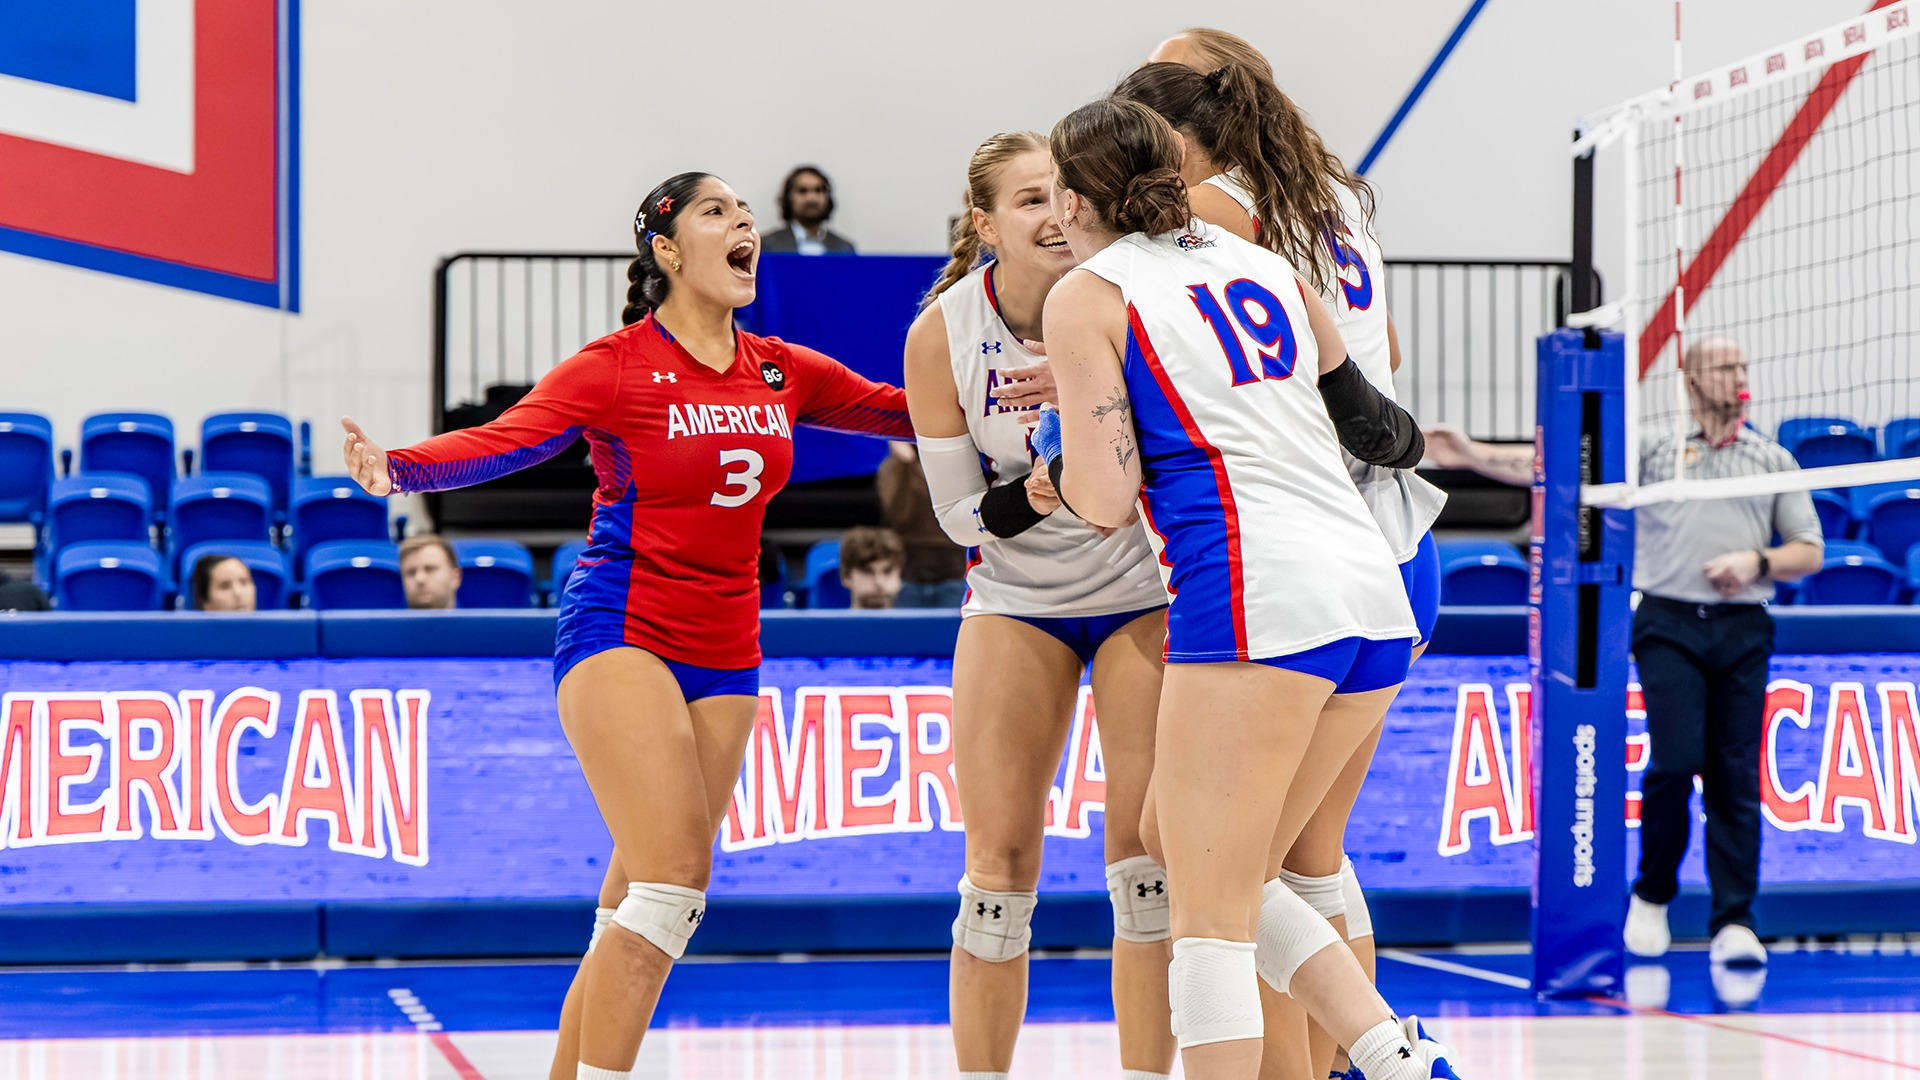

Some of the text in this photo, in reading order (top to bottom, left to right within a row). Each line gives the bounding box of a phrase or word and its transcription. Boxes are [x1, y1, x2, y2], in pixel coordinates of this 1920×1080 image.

[1313, 209, 1373, 311] 5
[1186, 278, 1297, 387] 19
[763, 368, 783, 383] BG
[667, 403, 793, 440] AMERICAN
[710, 448, 764, 508] 3
[1570, 724, 1598, 888] sports imports
